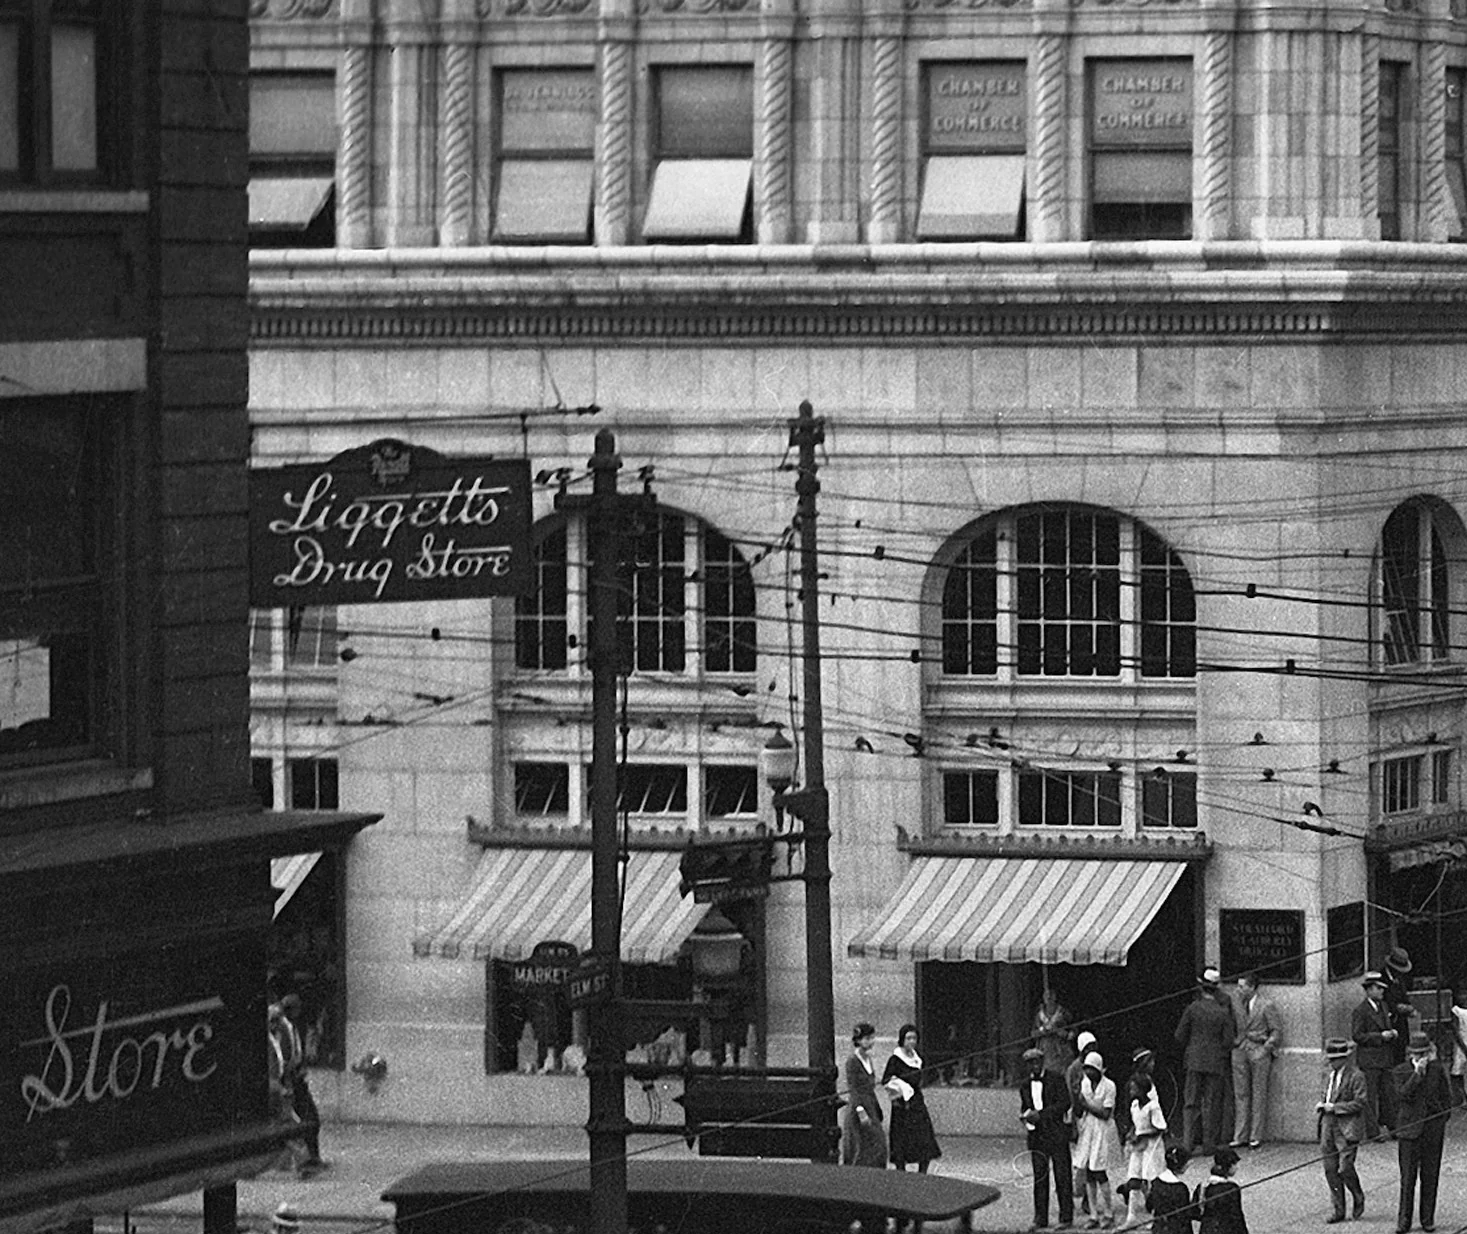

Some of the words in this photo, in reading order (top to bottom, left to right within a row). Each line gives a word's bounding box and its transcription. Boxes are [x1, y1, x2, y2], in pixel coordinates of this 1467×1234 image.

[937, 79, 1021, 96] CHAMBER
[1102, 75, 1185, 93] CHAMBER
[933, 115, 1023, 133] COMMERCE
[1098, 113, 1187, 130] COMMERCE
[273, 535, 393, 599] Drug
[406, 532, 513, 579] Store
[514, 966, 570, 985] MARKET
[571, 979, 591, 999] ELM
[20, 984, 225, 1123] Store
